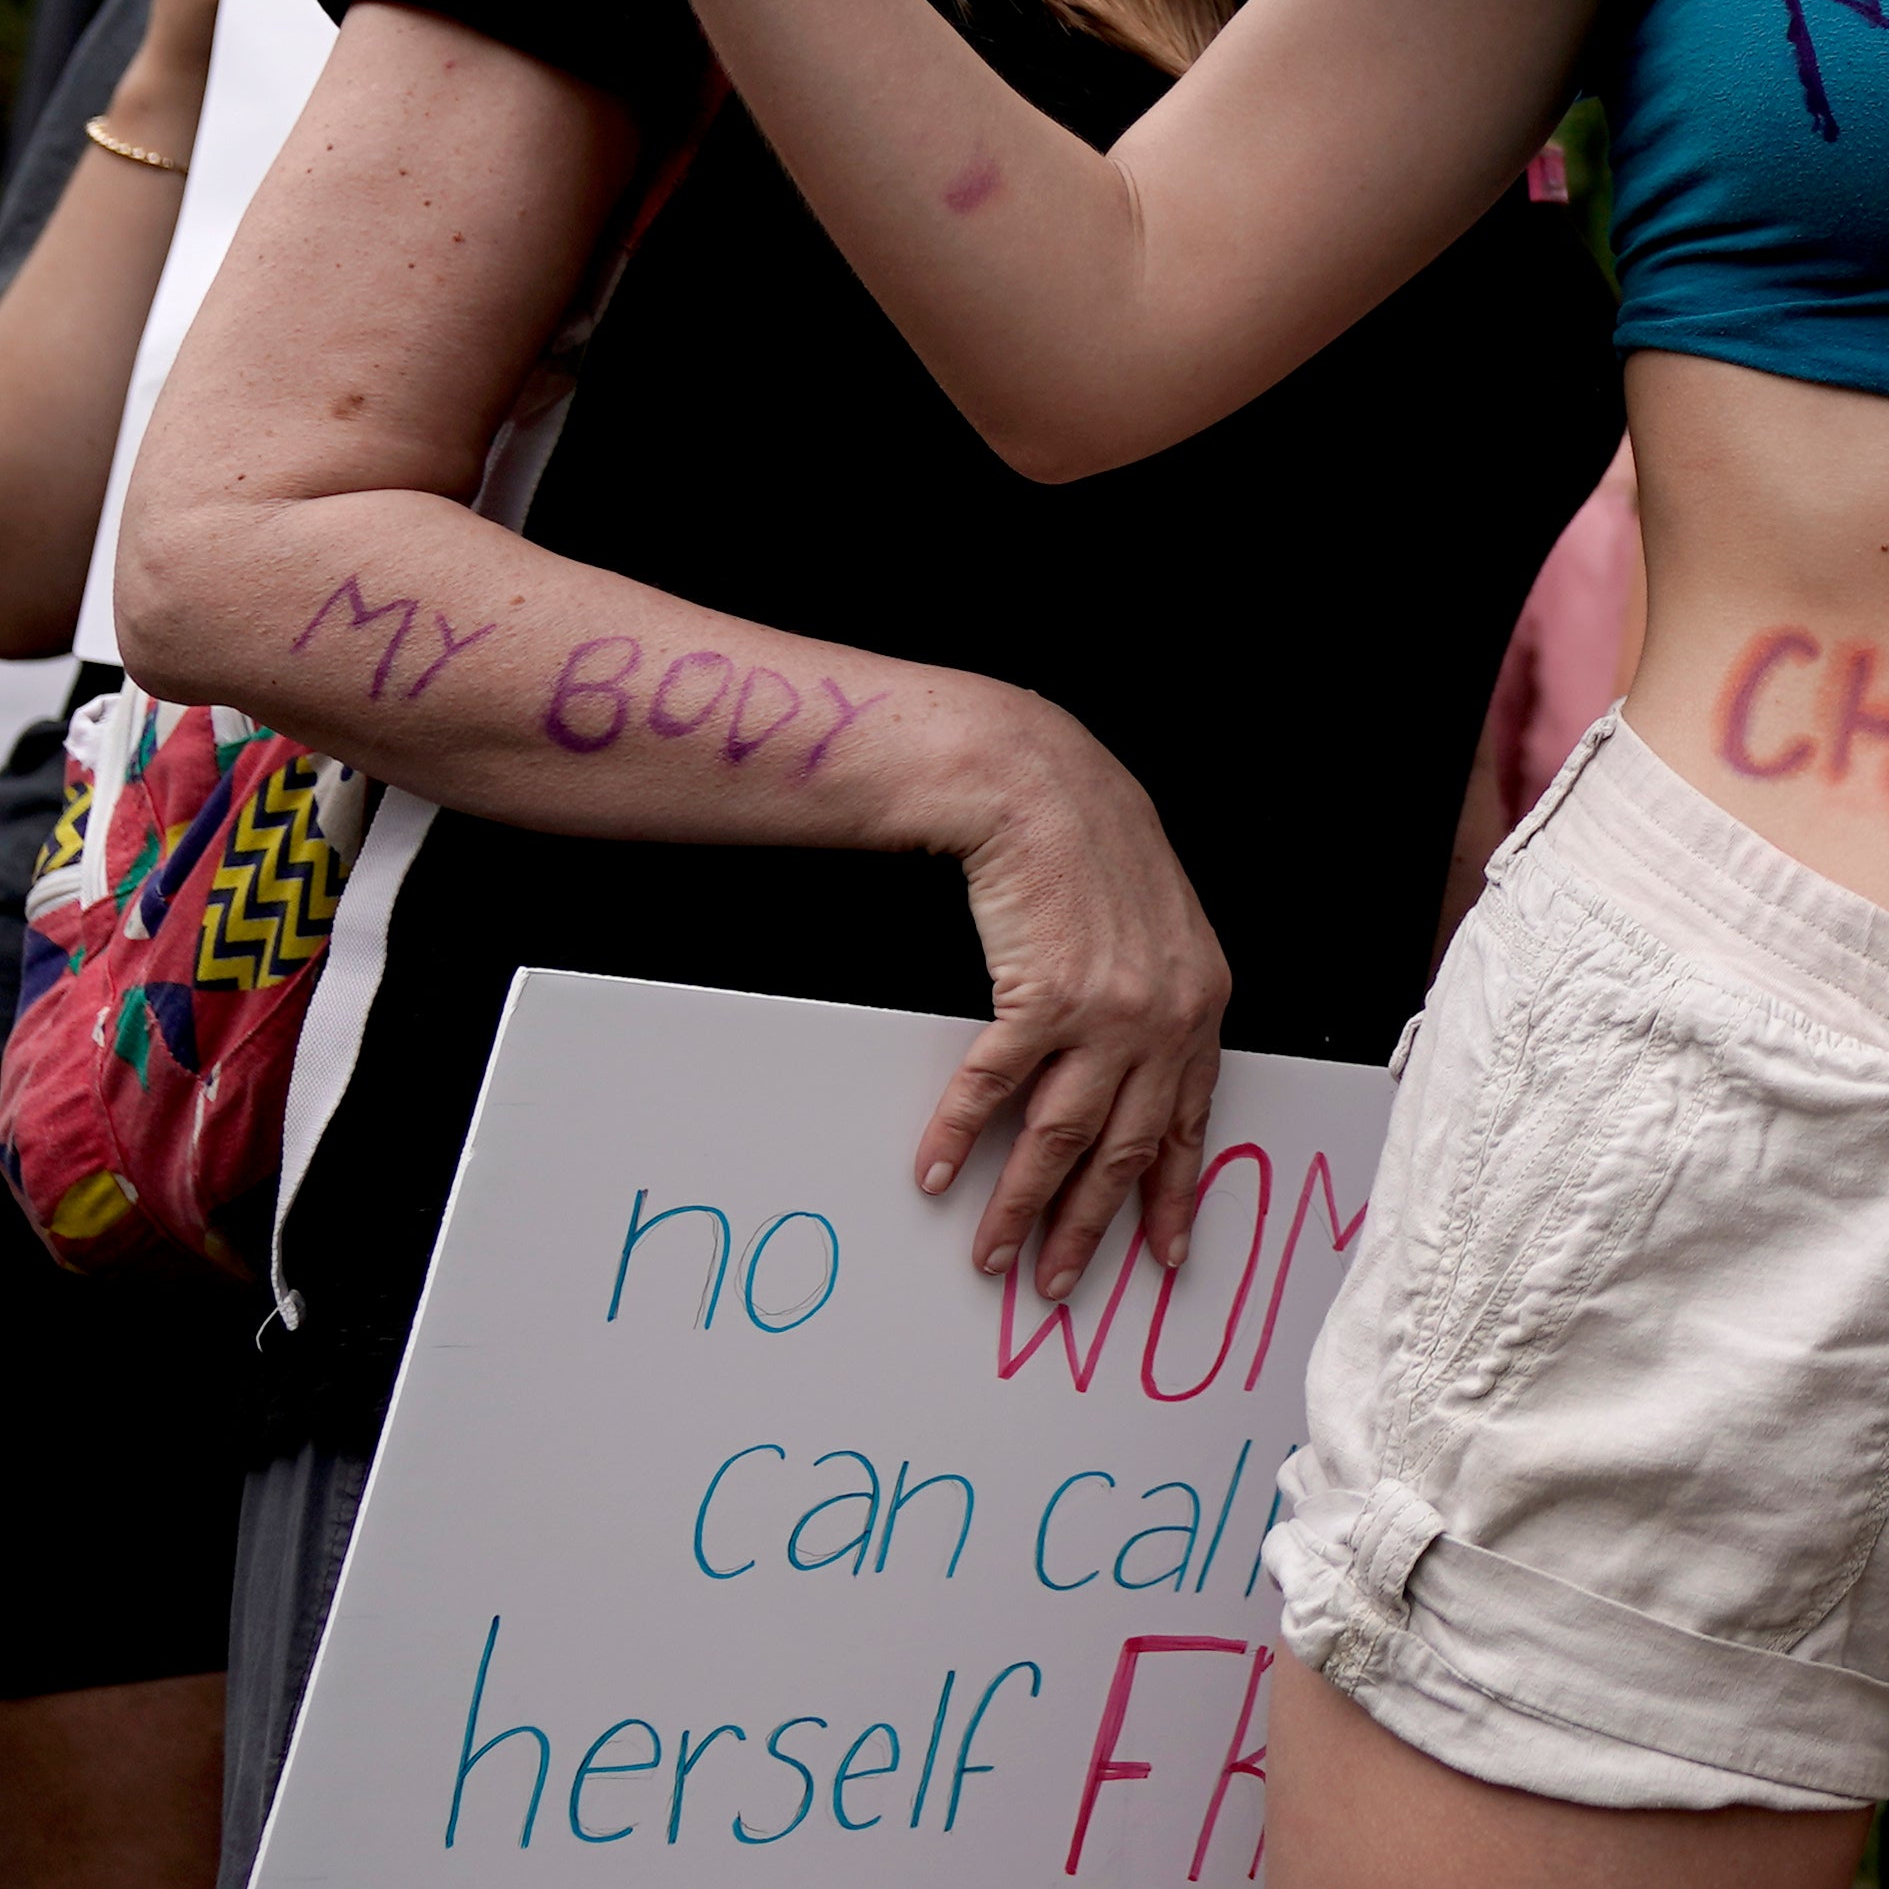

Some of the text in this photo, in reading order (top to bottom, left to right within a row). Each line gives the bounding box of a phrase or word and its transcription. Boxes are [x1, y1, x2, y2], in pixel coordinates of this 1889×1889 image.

[289, 574, 892, 784] MY BODY
[604, 1186, 842, 1334] no
[691, 1442, 977, 1581] can
[442, 1613, 1044, 1852] herself
